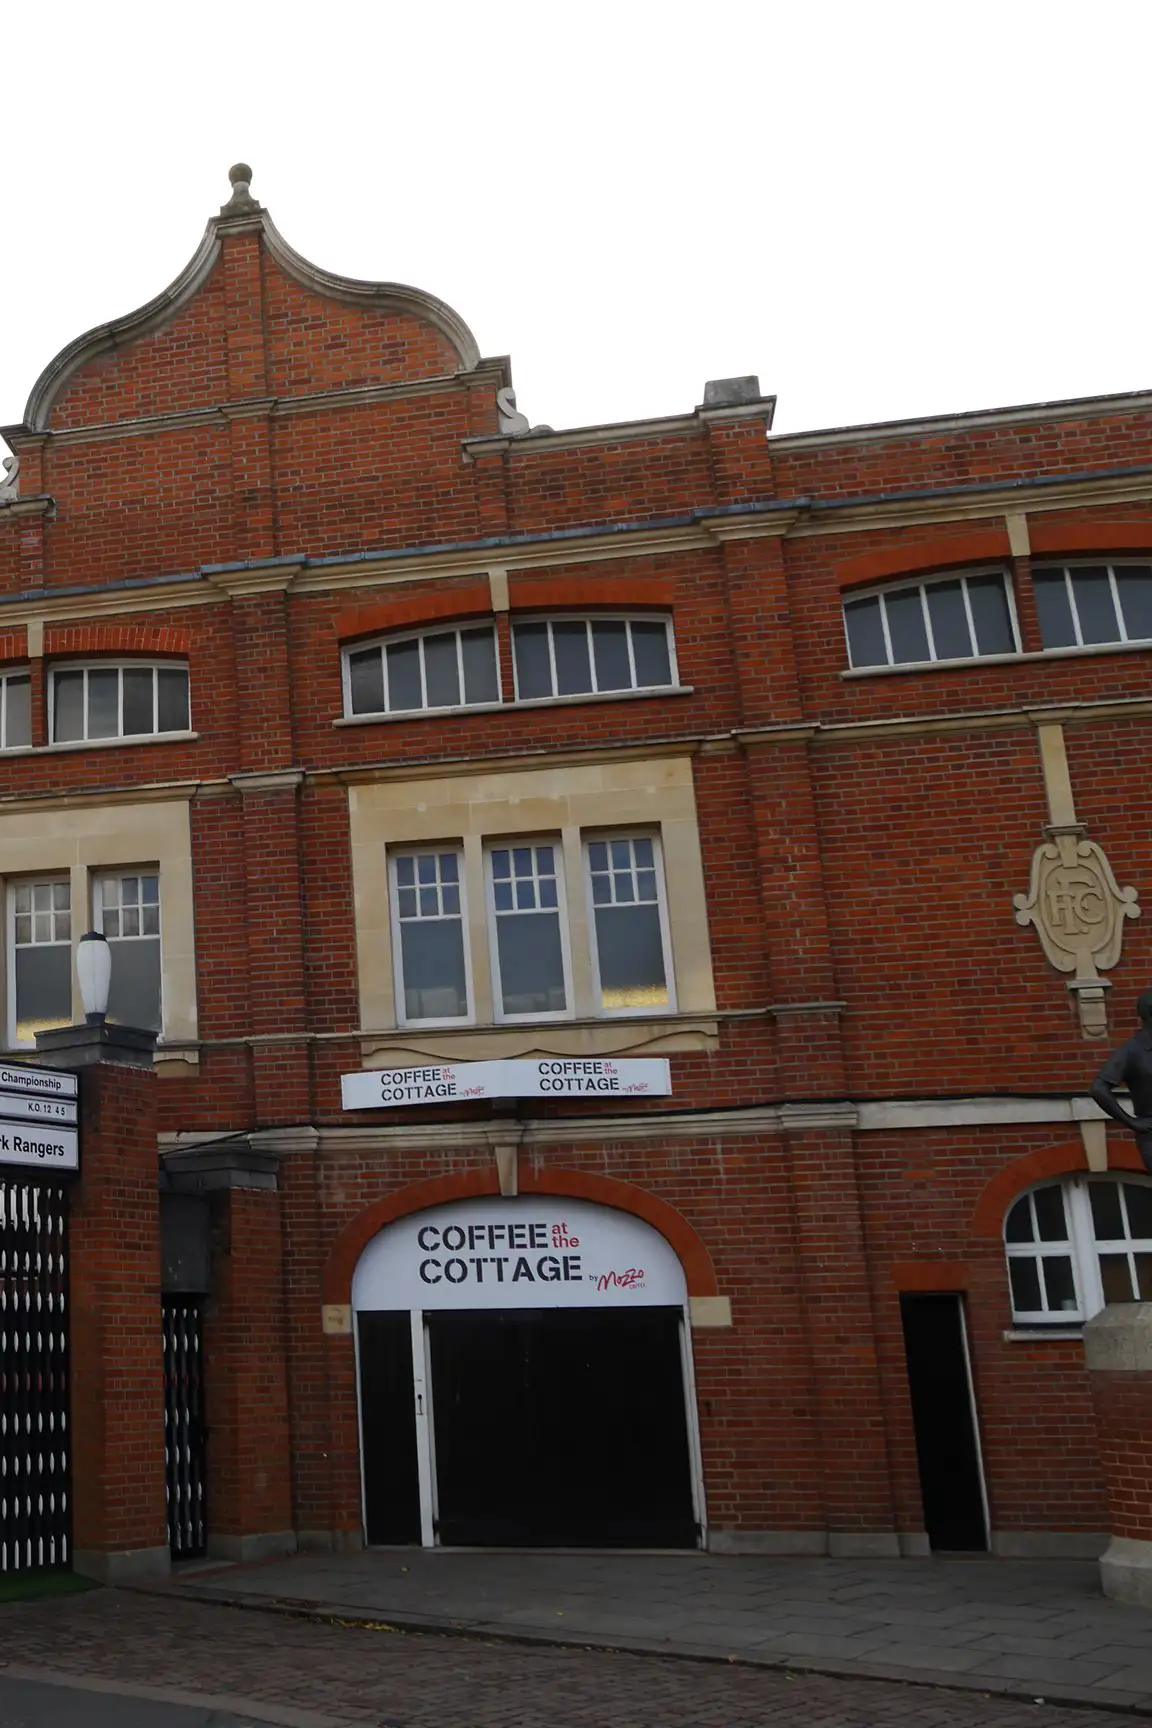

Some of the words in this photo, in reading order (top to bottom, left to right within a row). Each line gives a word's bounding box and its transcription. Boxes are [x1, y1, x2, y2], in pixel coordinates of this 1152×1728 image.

[381, 1068, 441, 1085] COFFEE
[538, 1062, 603, 1075] COFFEE
[1, 1071, 62, 1090] Championship
[539, 1077, 620, 1091] COTTAGE
[381, 1083, 457, 1101] COTTAGE
[13, 1135, 65, 1158] Rangers
[417, 1223, 549, 1251] COFFEE
[551, 1222, 569, 1234] at
[551, 1235, 580, 1249] the
[419, 1255, 583, 1284] COTTAGE
[589, 1274, 598, 1282] by
